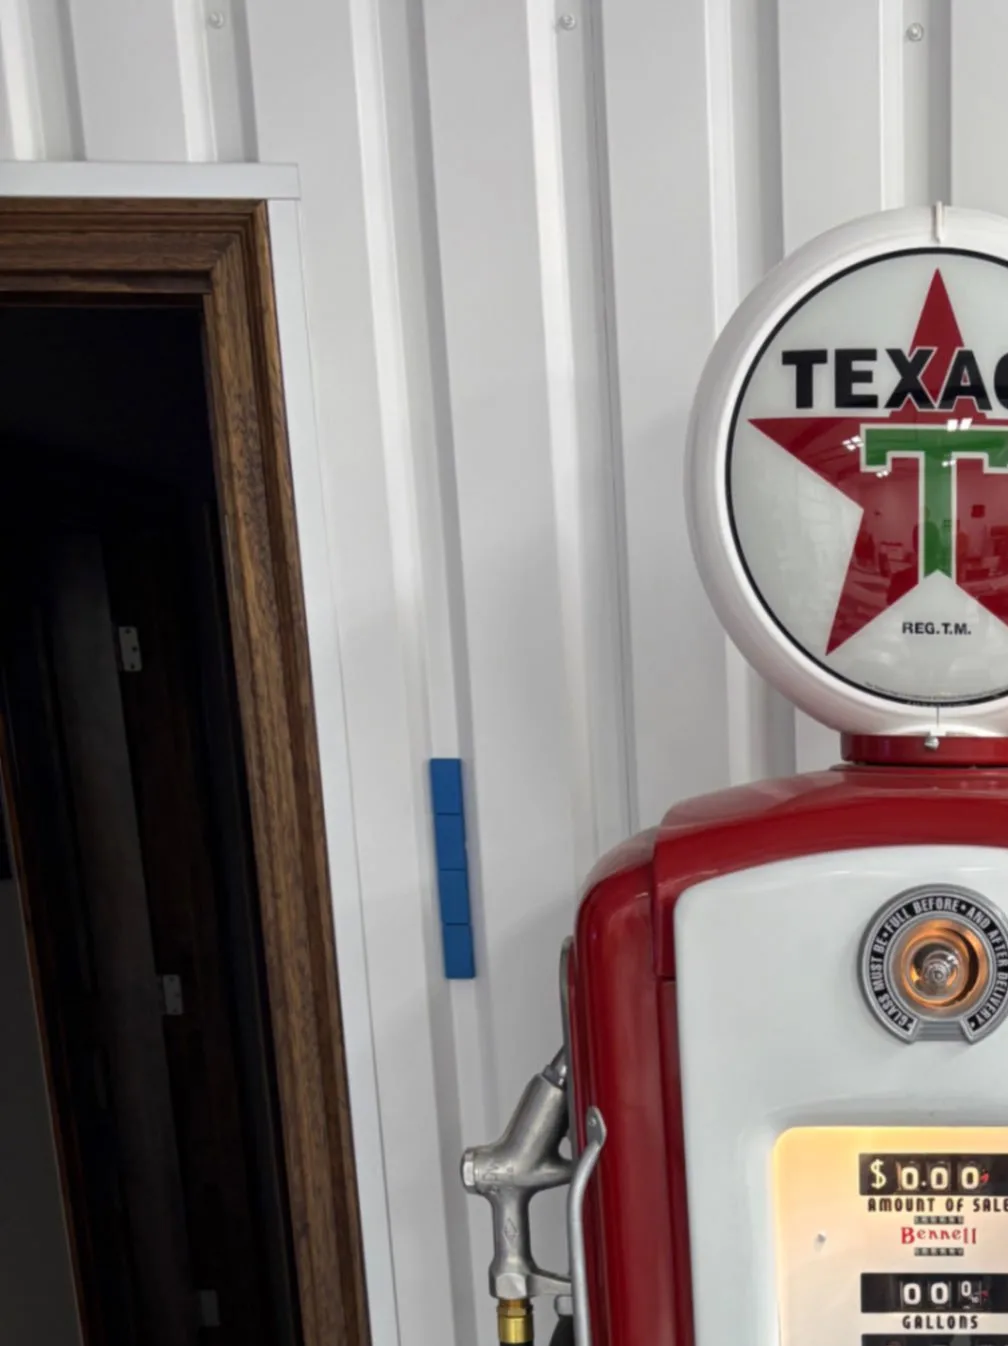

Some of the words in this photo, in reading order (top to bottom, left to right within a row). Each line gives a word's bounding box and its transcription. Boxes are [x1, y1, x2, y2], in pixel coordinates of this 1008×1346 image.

[912, 898, 959, 914] BEFORE
[886, 909, 911, 932] FULL
[965, 907, 991, 929] AND
[873, 936, 888, 954] BE
[987, 930, 1008, 967] AFTER
[871, 956, 883, 990] MUST
[867, 1198, 935, 1212] AMOUNT
[945, 1198, 965, 1212] OF
[902, 1315, 978, 1329] GALLONS
